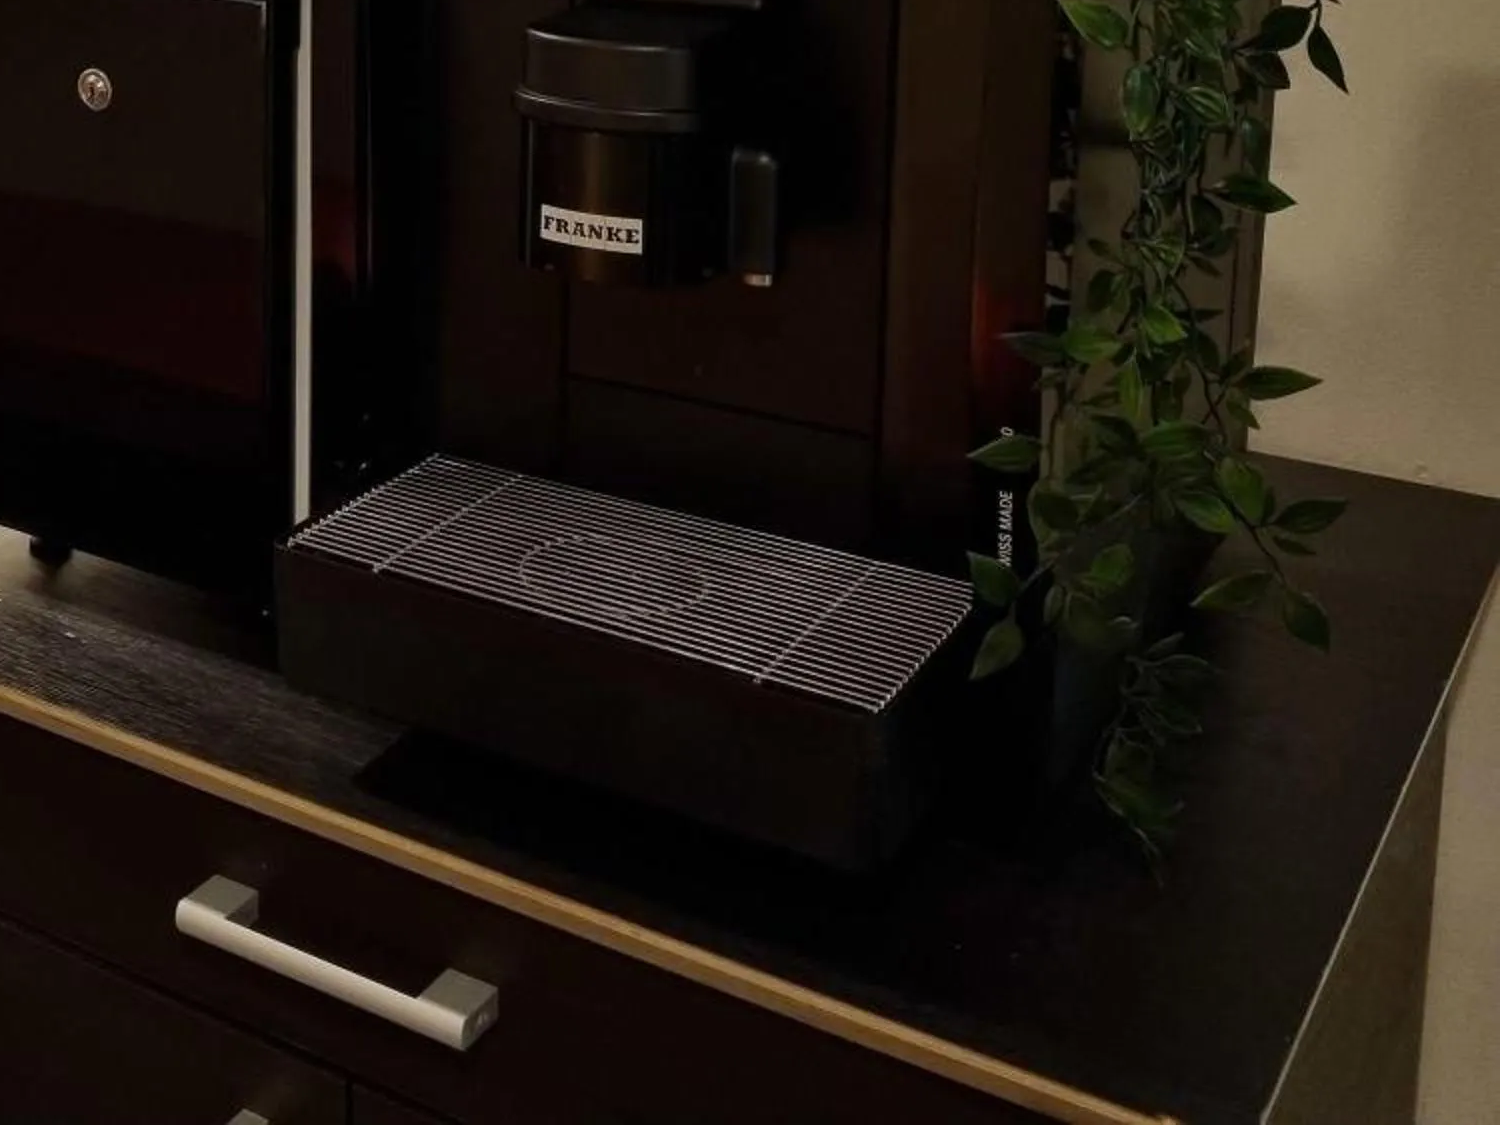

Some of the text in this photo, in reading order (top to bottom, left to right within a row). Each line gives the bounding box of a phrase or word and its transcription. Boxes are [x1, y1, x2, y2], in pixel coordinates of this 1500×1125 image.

[543, 215, 640, 244] FRANKE
[997, 490, 1013, 568] WISS MADE
